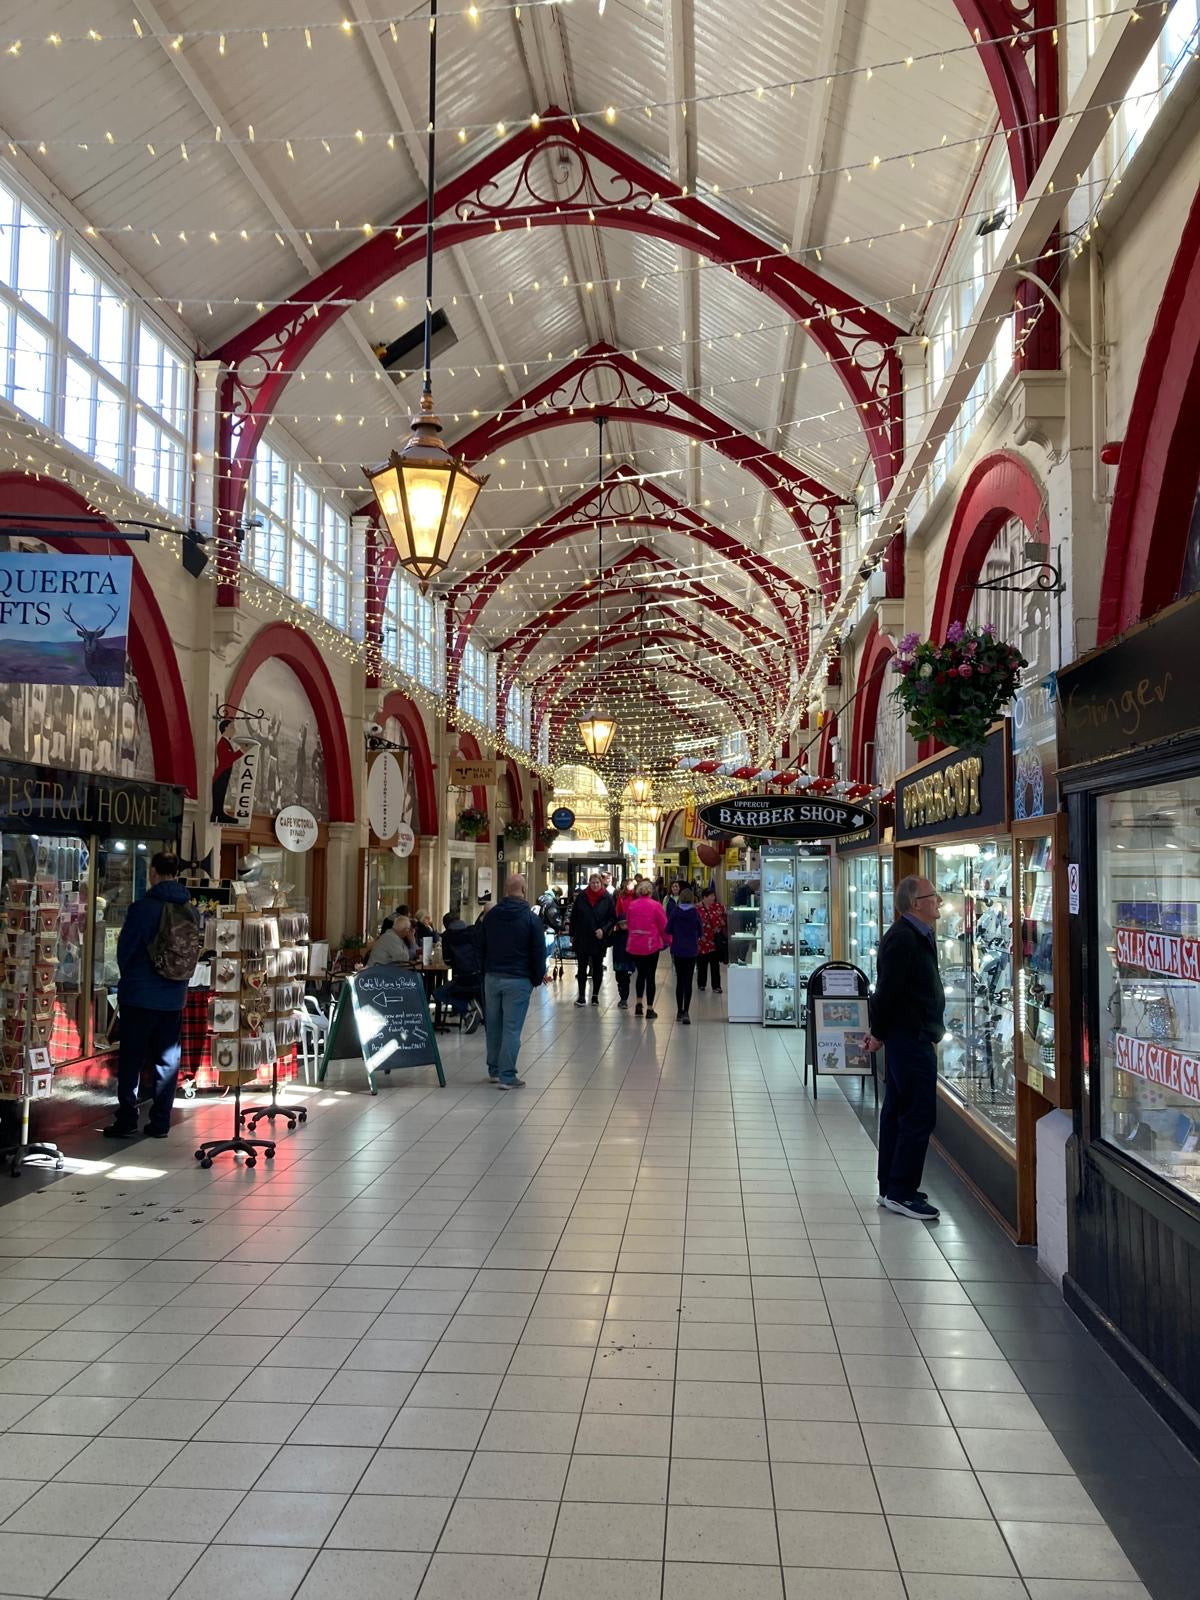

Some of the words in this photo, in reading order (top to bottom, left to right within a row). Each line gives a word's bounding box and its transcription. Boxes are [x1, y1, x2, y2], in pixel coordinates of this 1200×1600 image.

[1067, 671, 1173, 735] Ginger
[239, 754, 255, 808] CAFE
[902, 756, 982, 830] UPPERCUT
[97, 788, 158, 827] HOME
[280, 817, 293, 827] CAFE
[720, 808, 795, 827] BARBER
[800, 806, 847, 825] SHOP
[498, 850, 504, 861] 6
[1117, 929, 1144, 966] SALE
[1147, 935, 1178, 976] SALE
[1117, 1036, 1145, 1075] SALE
[1149, 1047, 1180, 1091] SALE
